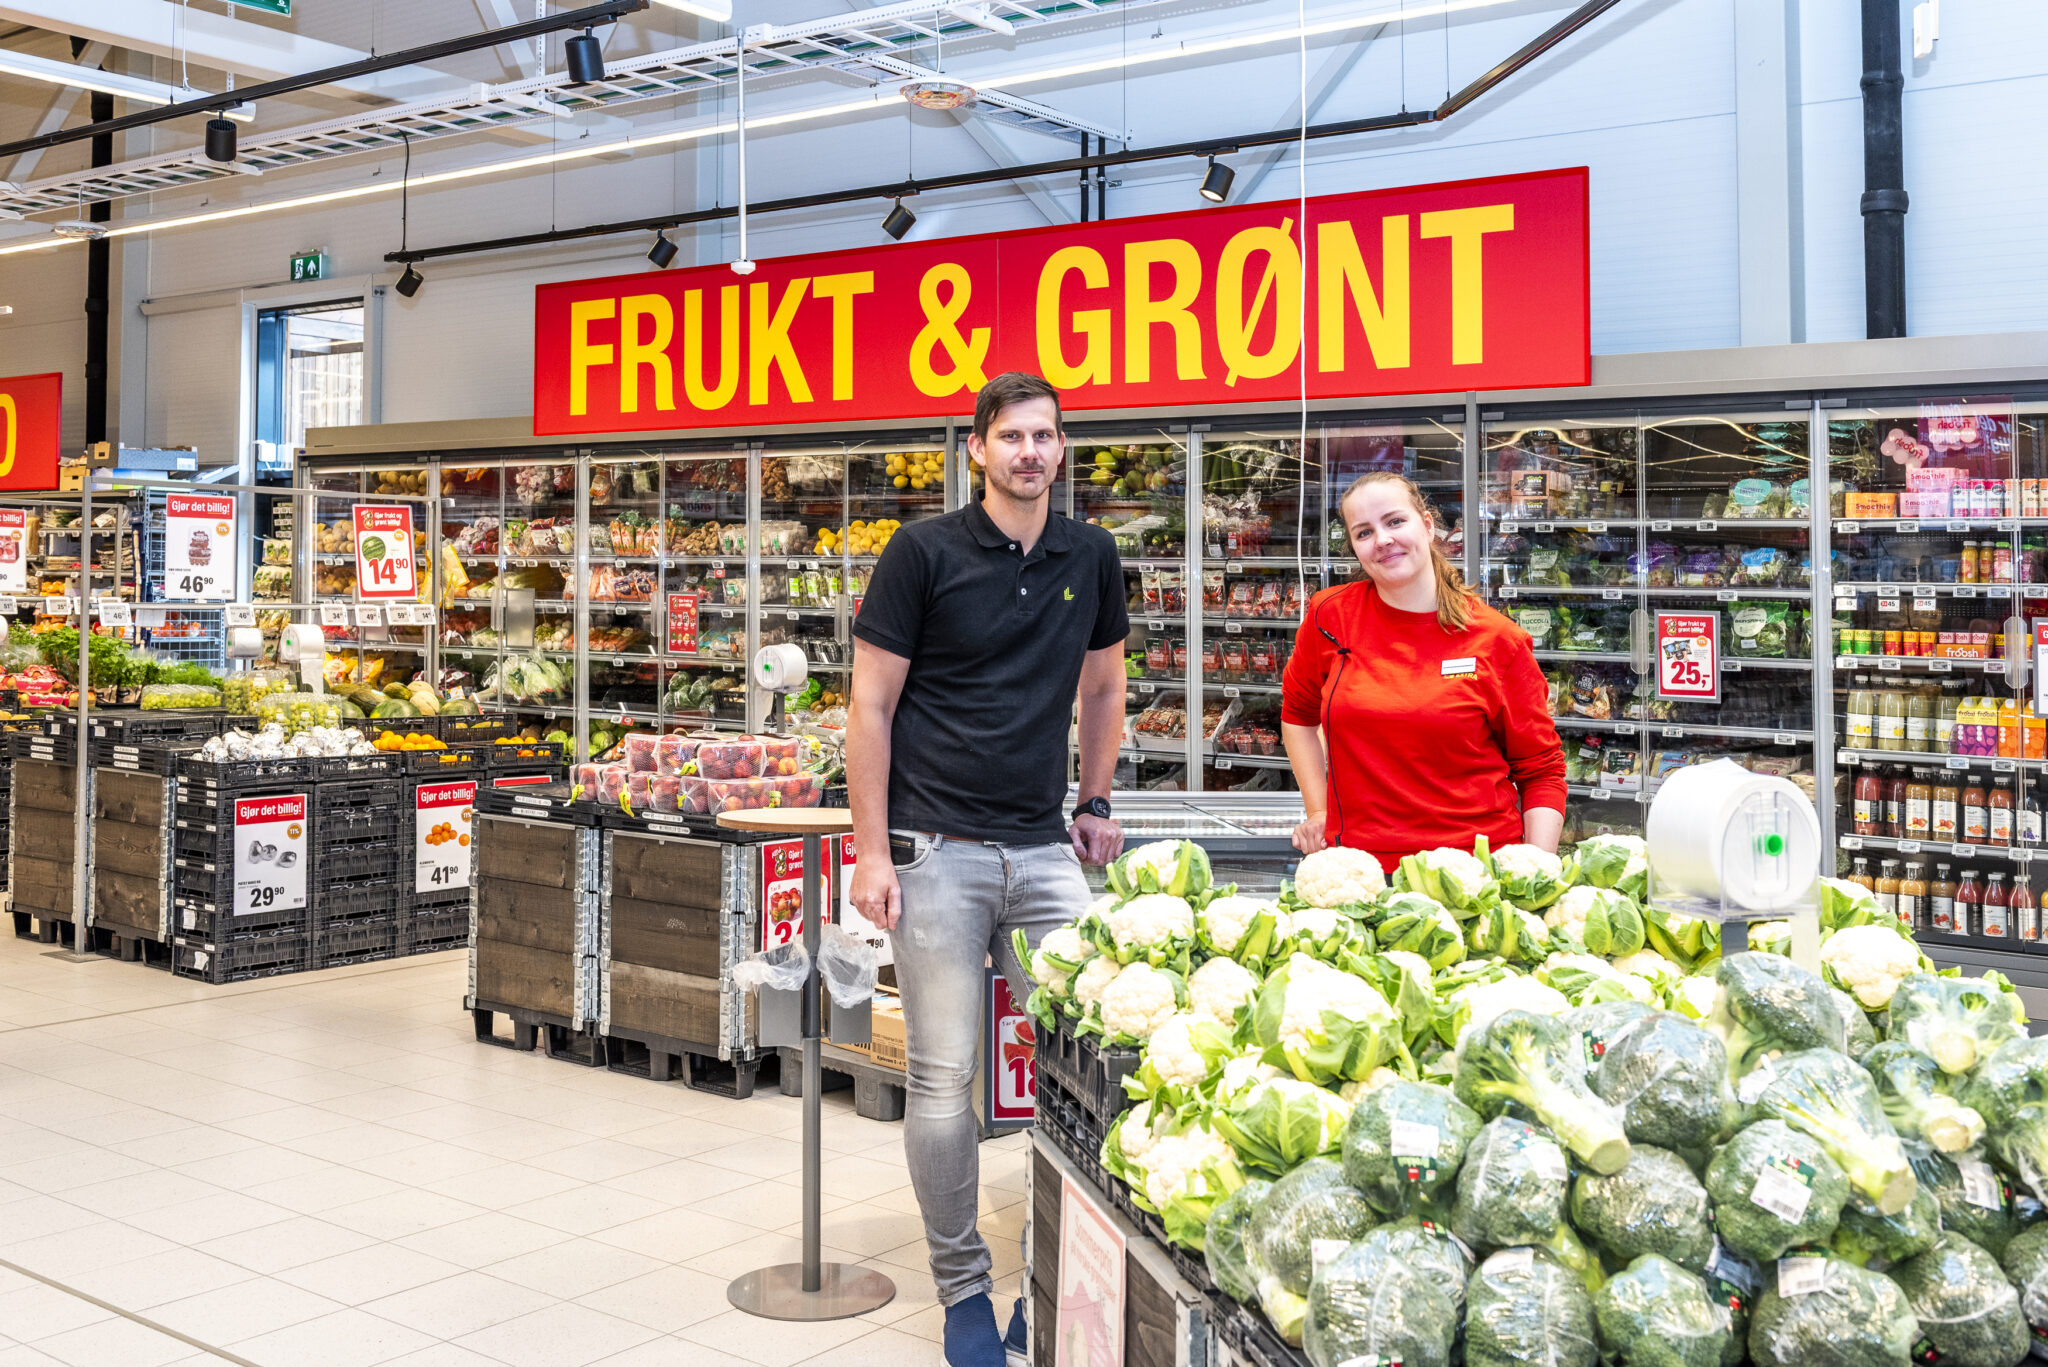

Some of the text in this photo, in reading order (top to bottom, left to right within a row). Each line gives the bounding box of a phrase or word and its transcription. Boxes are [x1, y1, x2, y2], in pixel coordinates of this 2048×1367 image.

[569, 203, 1514, 416] FRUKT & GRØNT
[171, 500, 230, 514] Gjør det billig!
[2, 514, 23, 524] billig!
[369, 558, 408, 585] 14 90
[180, 576, 204, 593] 46
[1671, 661, 1710, 688] 25,-
[421, 787, 474, 804] Gjør det billig!
[240, 802, 302, 819] Gjør det billig!
[788, 850, 800, 860] Gjør
[431, 865, 459, 884] 41 90
[250, 886, 285, 907] 29 90
